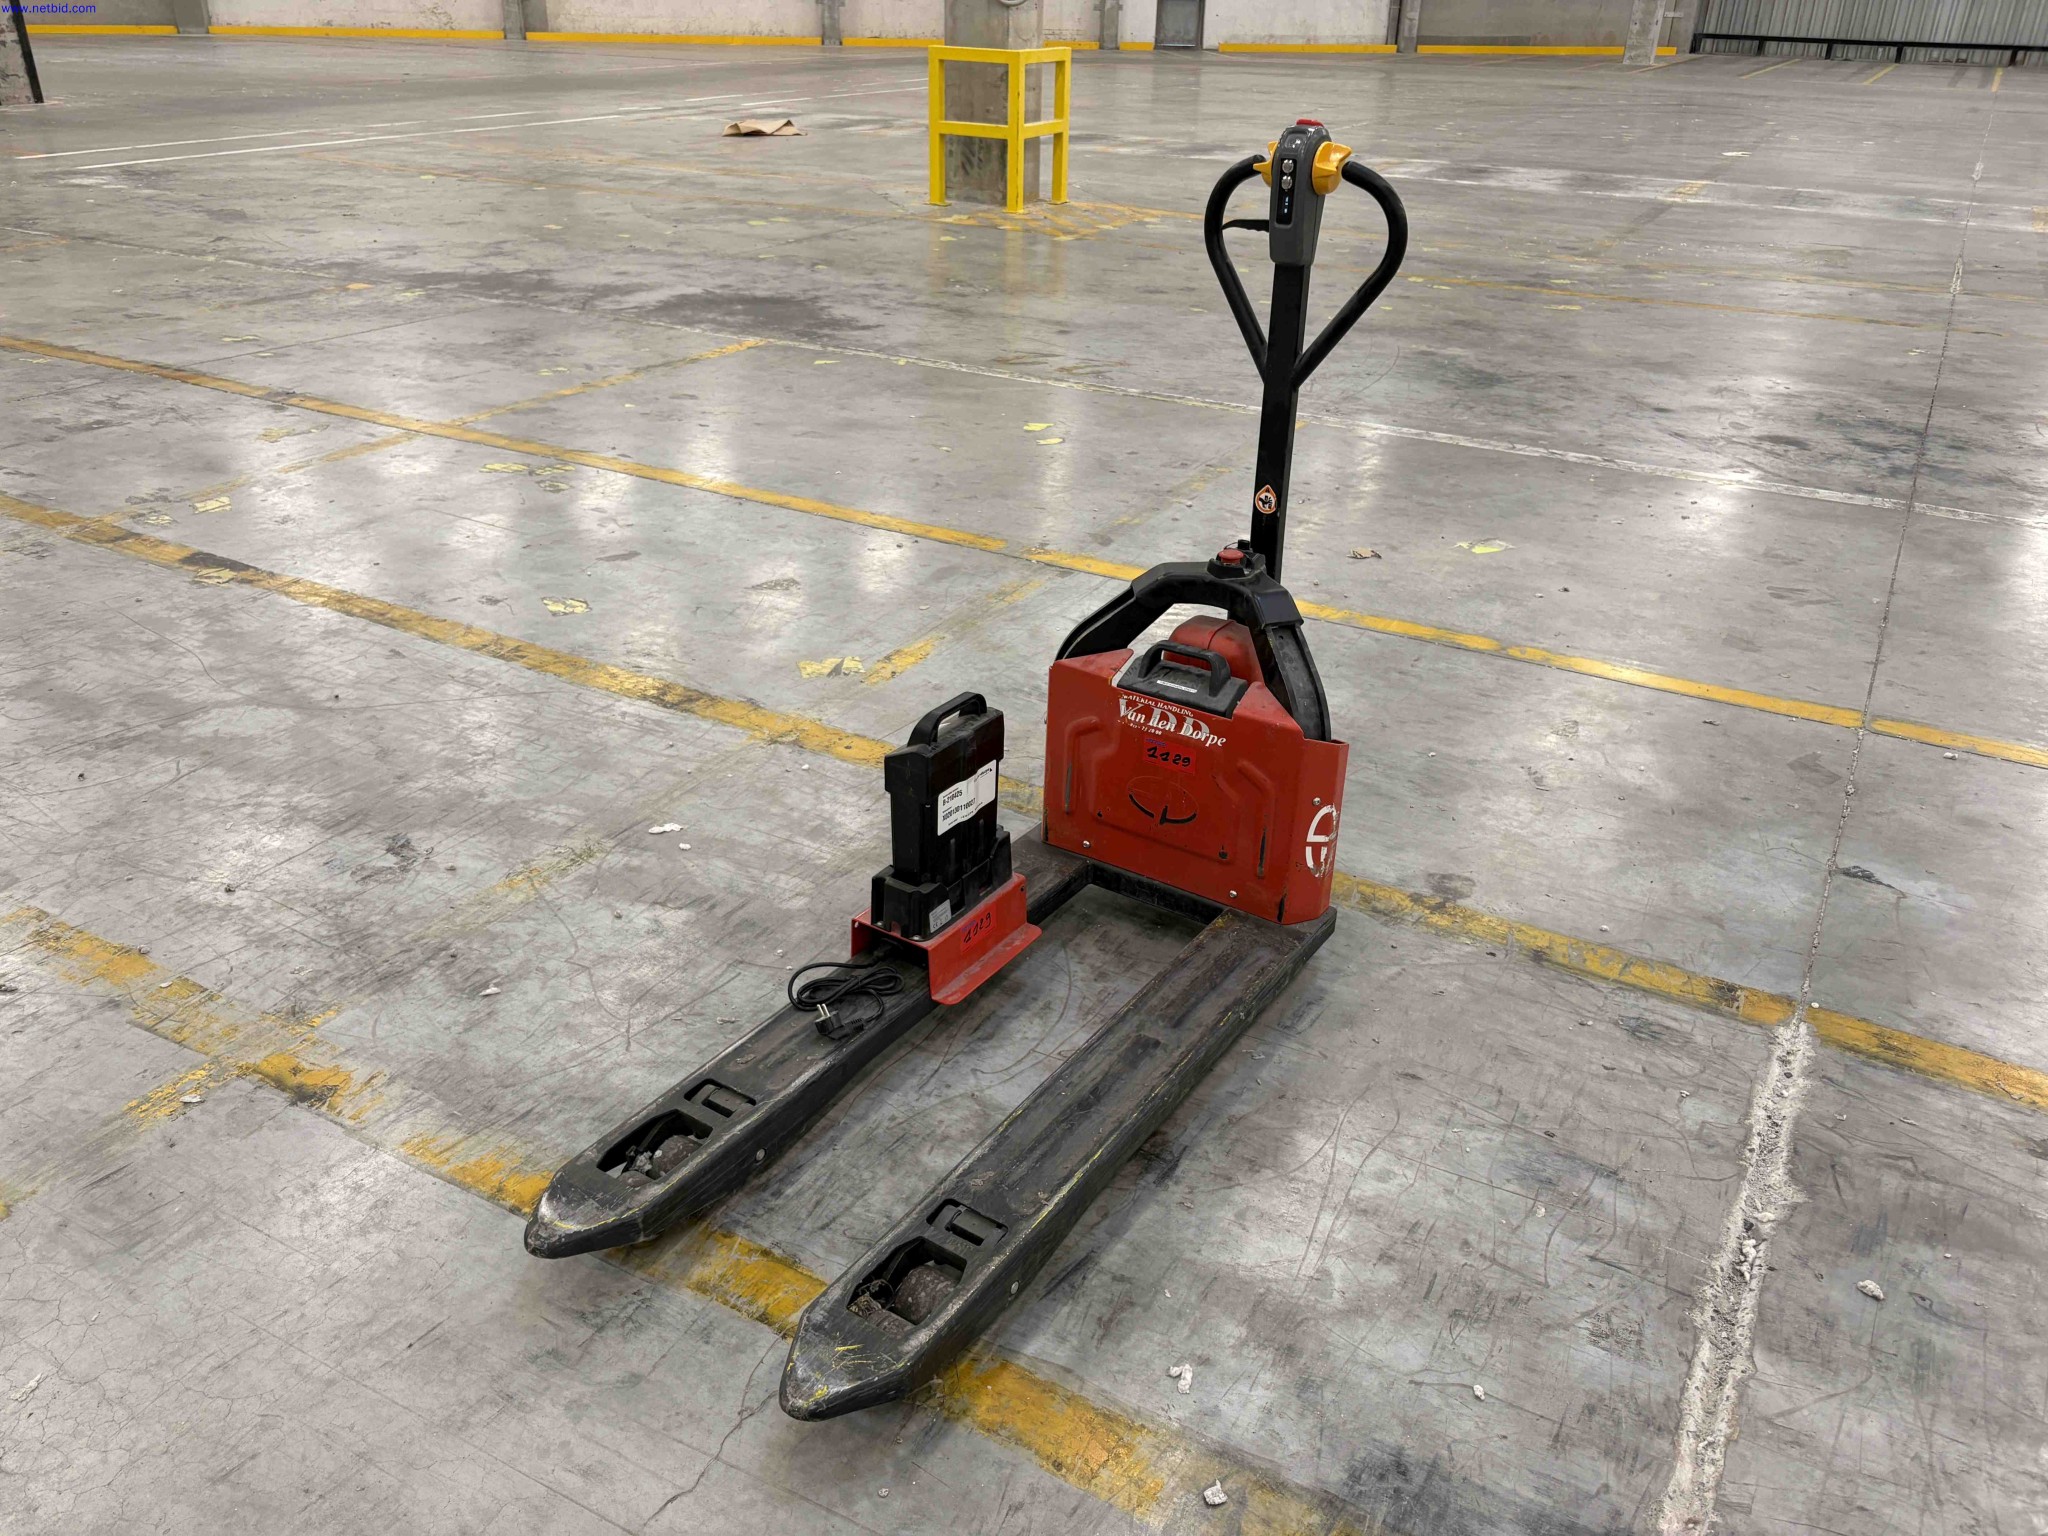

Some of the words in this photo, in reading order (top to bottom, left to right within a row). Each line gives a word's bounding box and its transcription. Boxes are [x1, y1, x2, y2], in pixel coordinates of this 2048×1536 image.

[1157, 702, 1194, 717] HANDLING
[1119, 704, 1145, 723] Van
[1147, 713, 1176, 732] den
[1178, 722, 1227, 747] Dorpe
[1147, 746, 1191, 767] 1129
[963, 911, 992, 943] 1129
